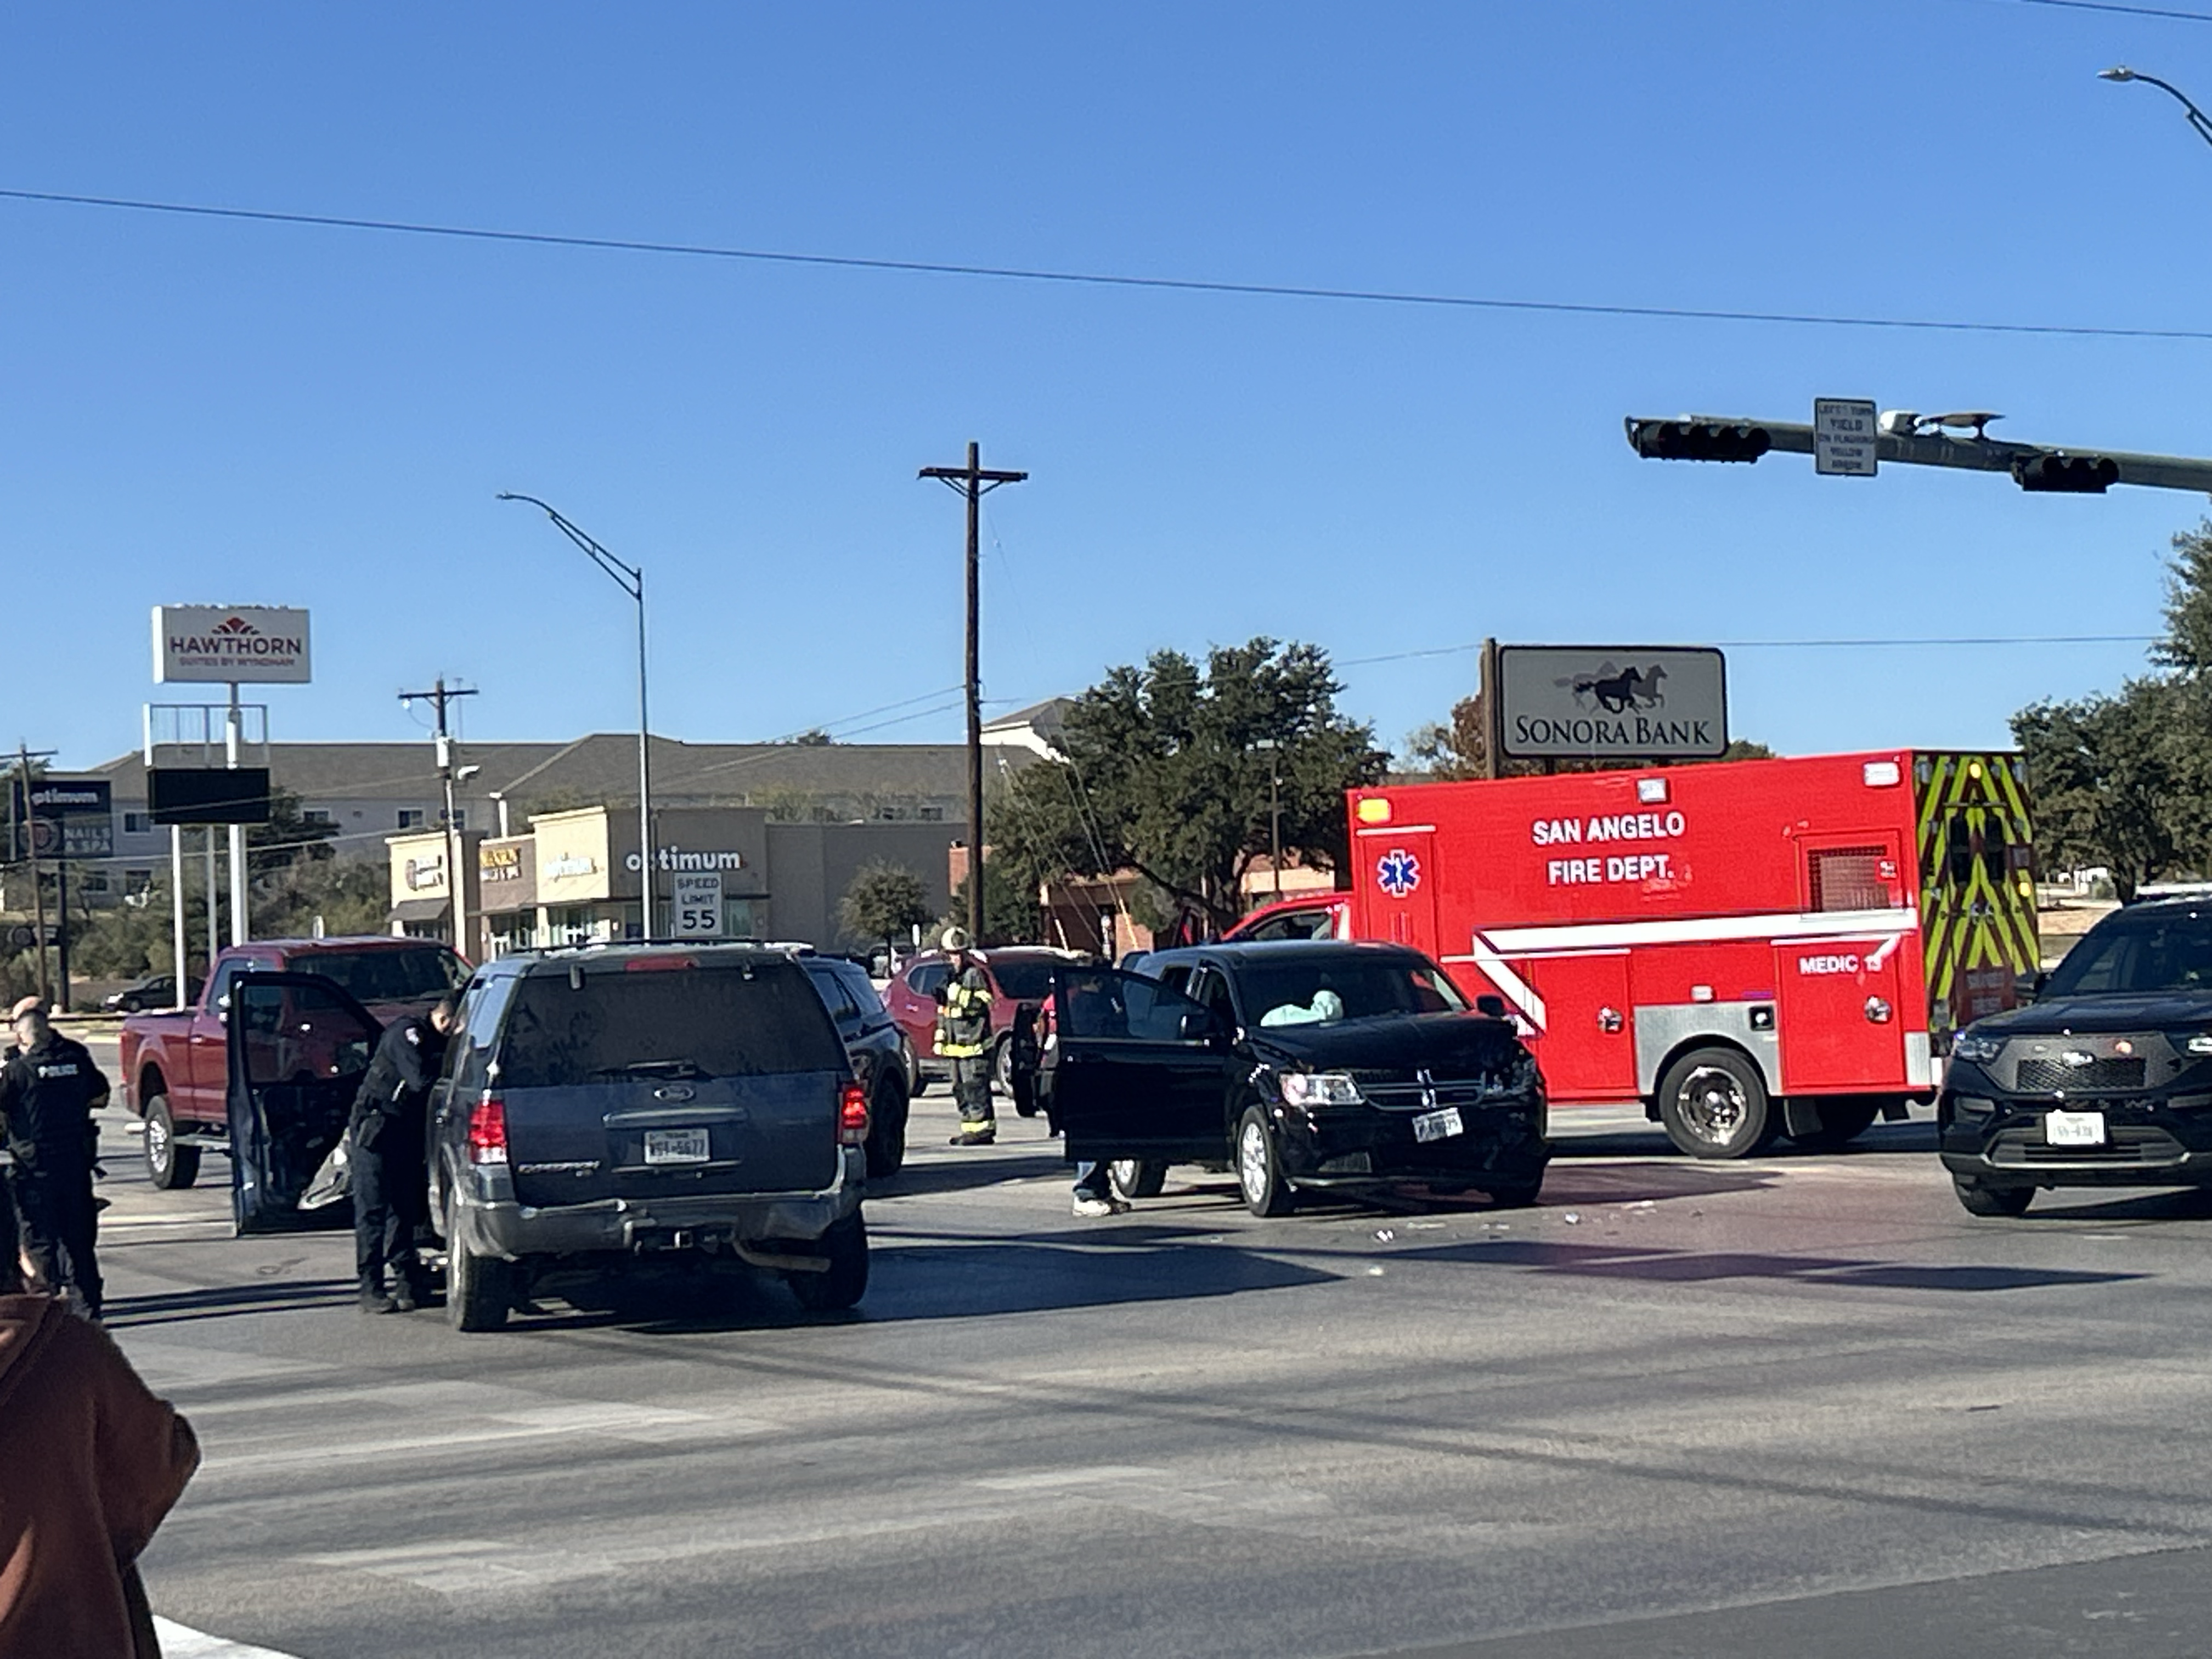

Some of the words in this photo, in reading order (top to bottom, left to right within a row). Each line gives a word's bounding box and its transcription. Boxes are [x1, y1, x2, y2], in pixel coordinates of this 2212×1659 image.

[1830, 419, 1863, 431] YIELD
[170, 636, 302, 654] HAWTHORN
[1515, 715, 1630, 744] SONORA
[1635, 717, 1712, 744] BANK
[64, 827, 111, 840] NAILS
[1532, 820, 1582, 845] SAN
[1587, 811, 1686, 842] ANGELO
[82, 840, 110, 853] SPA
[1548, 857, 1602, 885] FIRE
[1606, 854, 1674, 882] DEPT.
[676, 878, 720, 889] SPEED
[681, 894, 715, 905] LIMIT
[682, 909, 715, 929] 55
[1799, 954, 1859, 975] MEDIC
